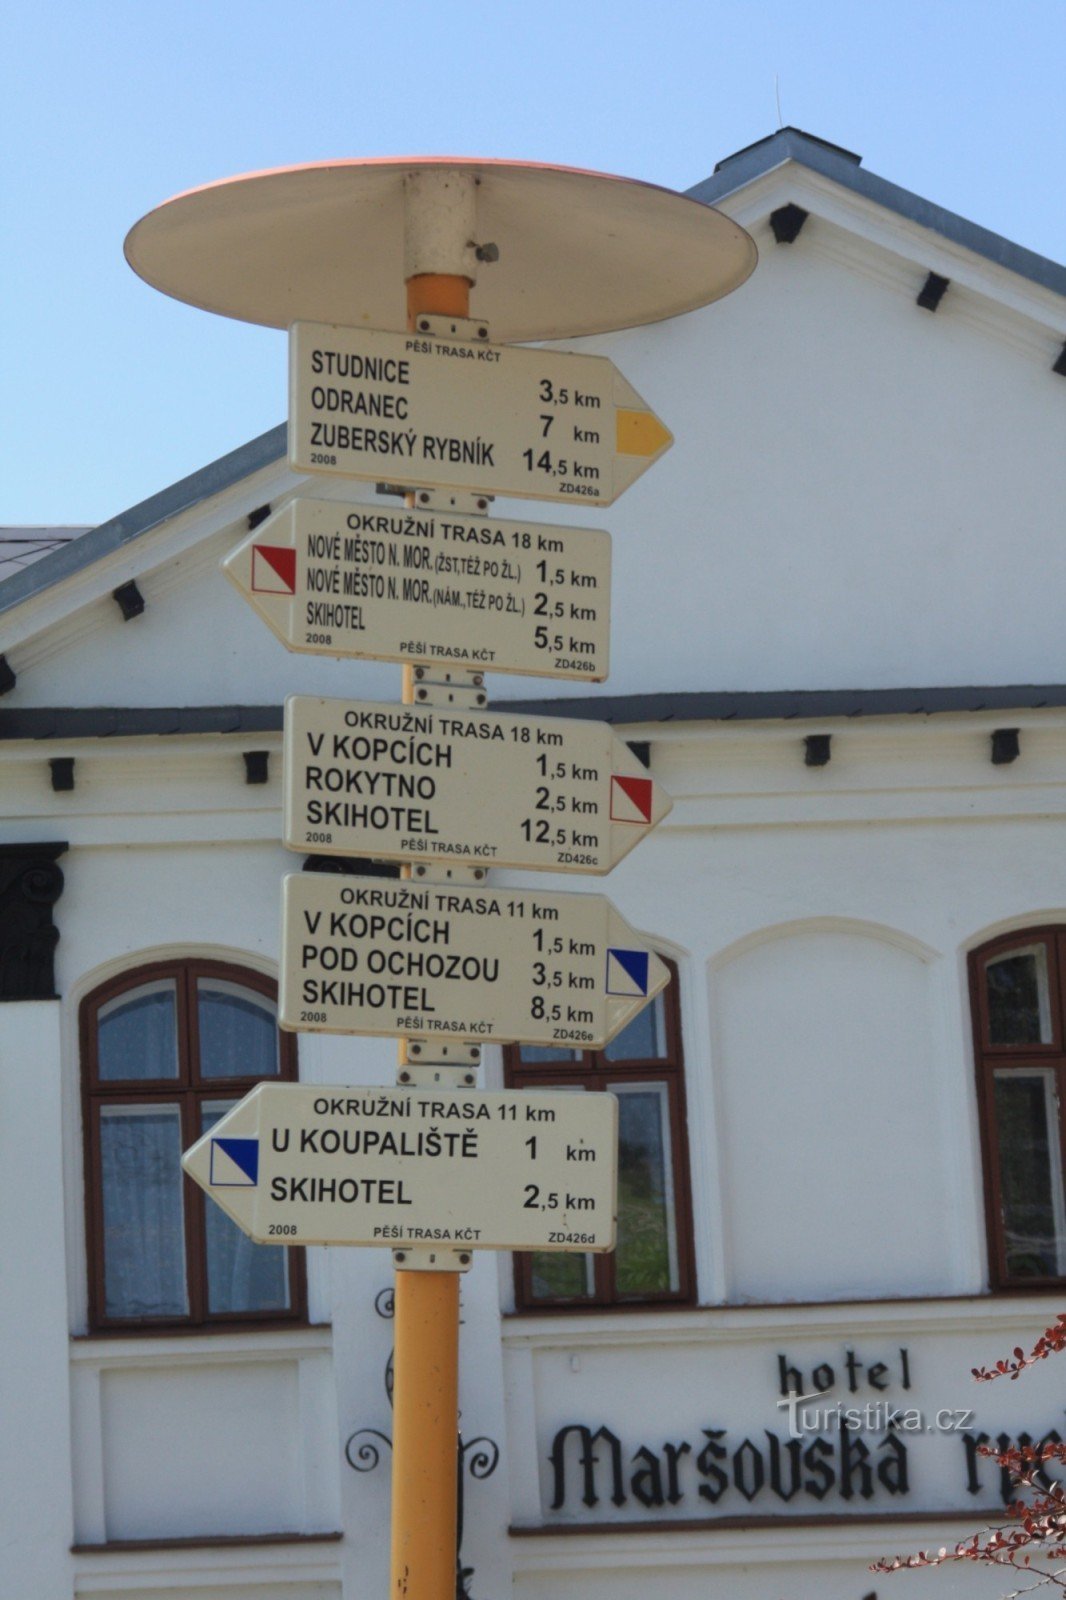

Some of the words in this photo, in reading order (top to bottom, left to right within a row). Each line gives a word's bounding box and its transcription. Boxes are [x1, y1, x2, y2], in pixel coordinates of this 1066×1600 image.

[406, 340, 432, 353] PĚŠÍ
[436, 345, 475, 359] TRASA
[478, 350, 501, 362] KČT
[311, 349, 410, 385] STUDNICE
[311, 386, 408, 420] ODRANEC
[539, 379, 569, 405] 3,5
[574, 390, 601, 409] km
[539, 414, 554, 438] 7
[573, 425, 600, 444] km
[310, 422, 417, 457] ZUBERSKÝ
[423, 435, 495, 467] RYBNÍK
[311, 453, 337, 465] 2008
[523, 448, 568, 477] 14,5
[573, 461, 599, 479] km
[559, 482, 600, 497] ZD426a
[346, 513, 434, 539] OKRUŽNÍ
[440, 523, 506, 547] TRASA
[511, 532, 531, 549] 18
[537, 534, 564, 553] km
[308, 531, 341, 560] NOVÉ
[344, 533, 385, 565] MĚSTO
[389, 543, 399, 566] N.
[403, 544, 433, 570] MOR.
[483, 560, 499, 578] PO
[536, 559, 565, 586] 1,5
[571, 570, 597, 588] km
[307, 568, 340, 594] NOVÉ
[344, 568, 385, 599] MĚSTO
[387, 577, 399, 600] N.
[402, 578, 433, 604] MOR.
[488, 594, 504, 611] PO
[306, 601, 366, 631] SKIHOTEL
[533, 592, 564, 619] 2,5
[570, 603, 596, 621] km
[306, 632, 332, 645] 2008
[400, 641, 426, 654] PĚŠÍ
[429, 645, 469, 659] TRASA
[472, 648, 496, 661] KČT
[534, 625, 564, 653] 5,5
[569, 636, 595, 654] km
[554, 658, 596, 672] ZD426b
[344, 710, 433, 734] OKRUŽNÍ
[438, 719, 505, 741] TRASA
[511, 726, 531, 743] 18
[537, 728, 563, 746] km
[307, 732, 325, 757] V
[333, 734, 452, 768] KOPCÍCH
[536, 753, 566, 780] 1,5
[572, 763, 598, 781] km
[305, 765, 436, 800] ROKYTNO
[535, 786, 566, 813] 2,5
[572, 796, 598, 815] km
[306, 799, 439, 834] SKIHOTEL
[306, 832, 332, 843] 2008
[401, 838, 427, 851] PĚŠÍ
[431, 841, 471, 855] TRASA
[474, 844, 497, 856] KČT
[520, 818, 566, 847] 12,5
[572, 830, 598, 848] km
[557, 852, 598, 865] ZD426c
[340, 888, 429, 910] OKRUŽNÍ
[435, 895, 501, 916] TRASA
[507, 901, 524, 918] 11
[532, 903, 559, 921] km
[303, 910, 322, 935] V
[330, 912, 450, 945] KOPCÍCH
[532, 928, 563, 955] 1,5
[569, 938, 595, 956] km
[302, 944, 358, 972] POD
[367, 949, 499, 983] OCHOZOU
[532, 962, 563, 989] 3,5
[568, 972, 595, 990] km
[302, 979, 435, 1012] SKIHOTEL
[530, 995, 561, 1023] 8,5
[567, 1005, 593, 1023] km
[300, 1011, 327, 1023] 2008
[397, 1016, 423, 1029] PĚŠÍ
[427, 1019, 467, 1032] TRASA
[470, 1021, 494, 1034] KČT
[553, 1029, 593, 1040] ZD426e
[313, 1096, 411, 1117] OKRUŽNÍ
[417, 1101, 491, 1120] TRASA
[498, 1104, 517, 1121] 11
[526, 1105, 556, 1122] km
[272, 1128, 290, 1153] U
[300, 1126, 478, 1158] KOUPALIŠTĚ
[525, 1135, 537, 1160] 1
[566, 1144, 596, 1162] km
[270, 1176, 413, 1205] SKIHOTEL
[523, 1184, 559, 1212] 2,5
[565, 1193, 595, 1210] km
[269, 1224, 297, 1236] 2008
[373, 1225, 403, 1238] PĚŠÍ
[407, 1228, 451, 1239] TRASA
[455, 1227, 481, 1240] KČT
[548, 1232, 595, 1243] ZD426d
[777, 1348, 912, 1397] hotel
[547, 1412, 911, 1511] Maršovská
